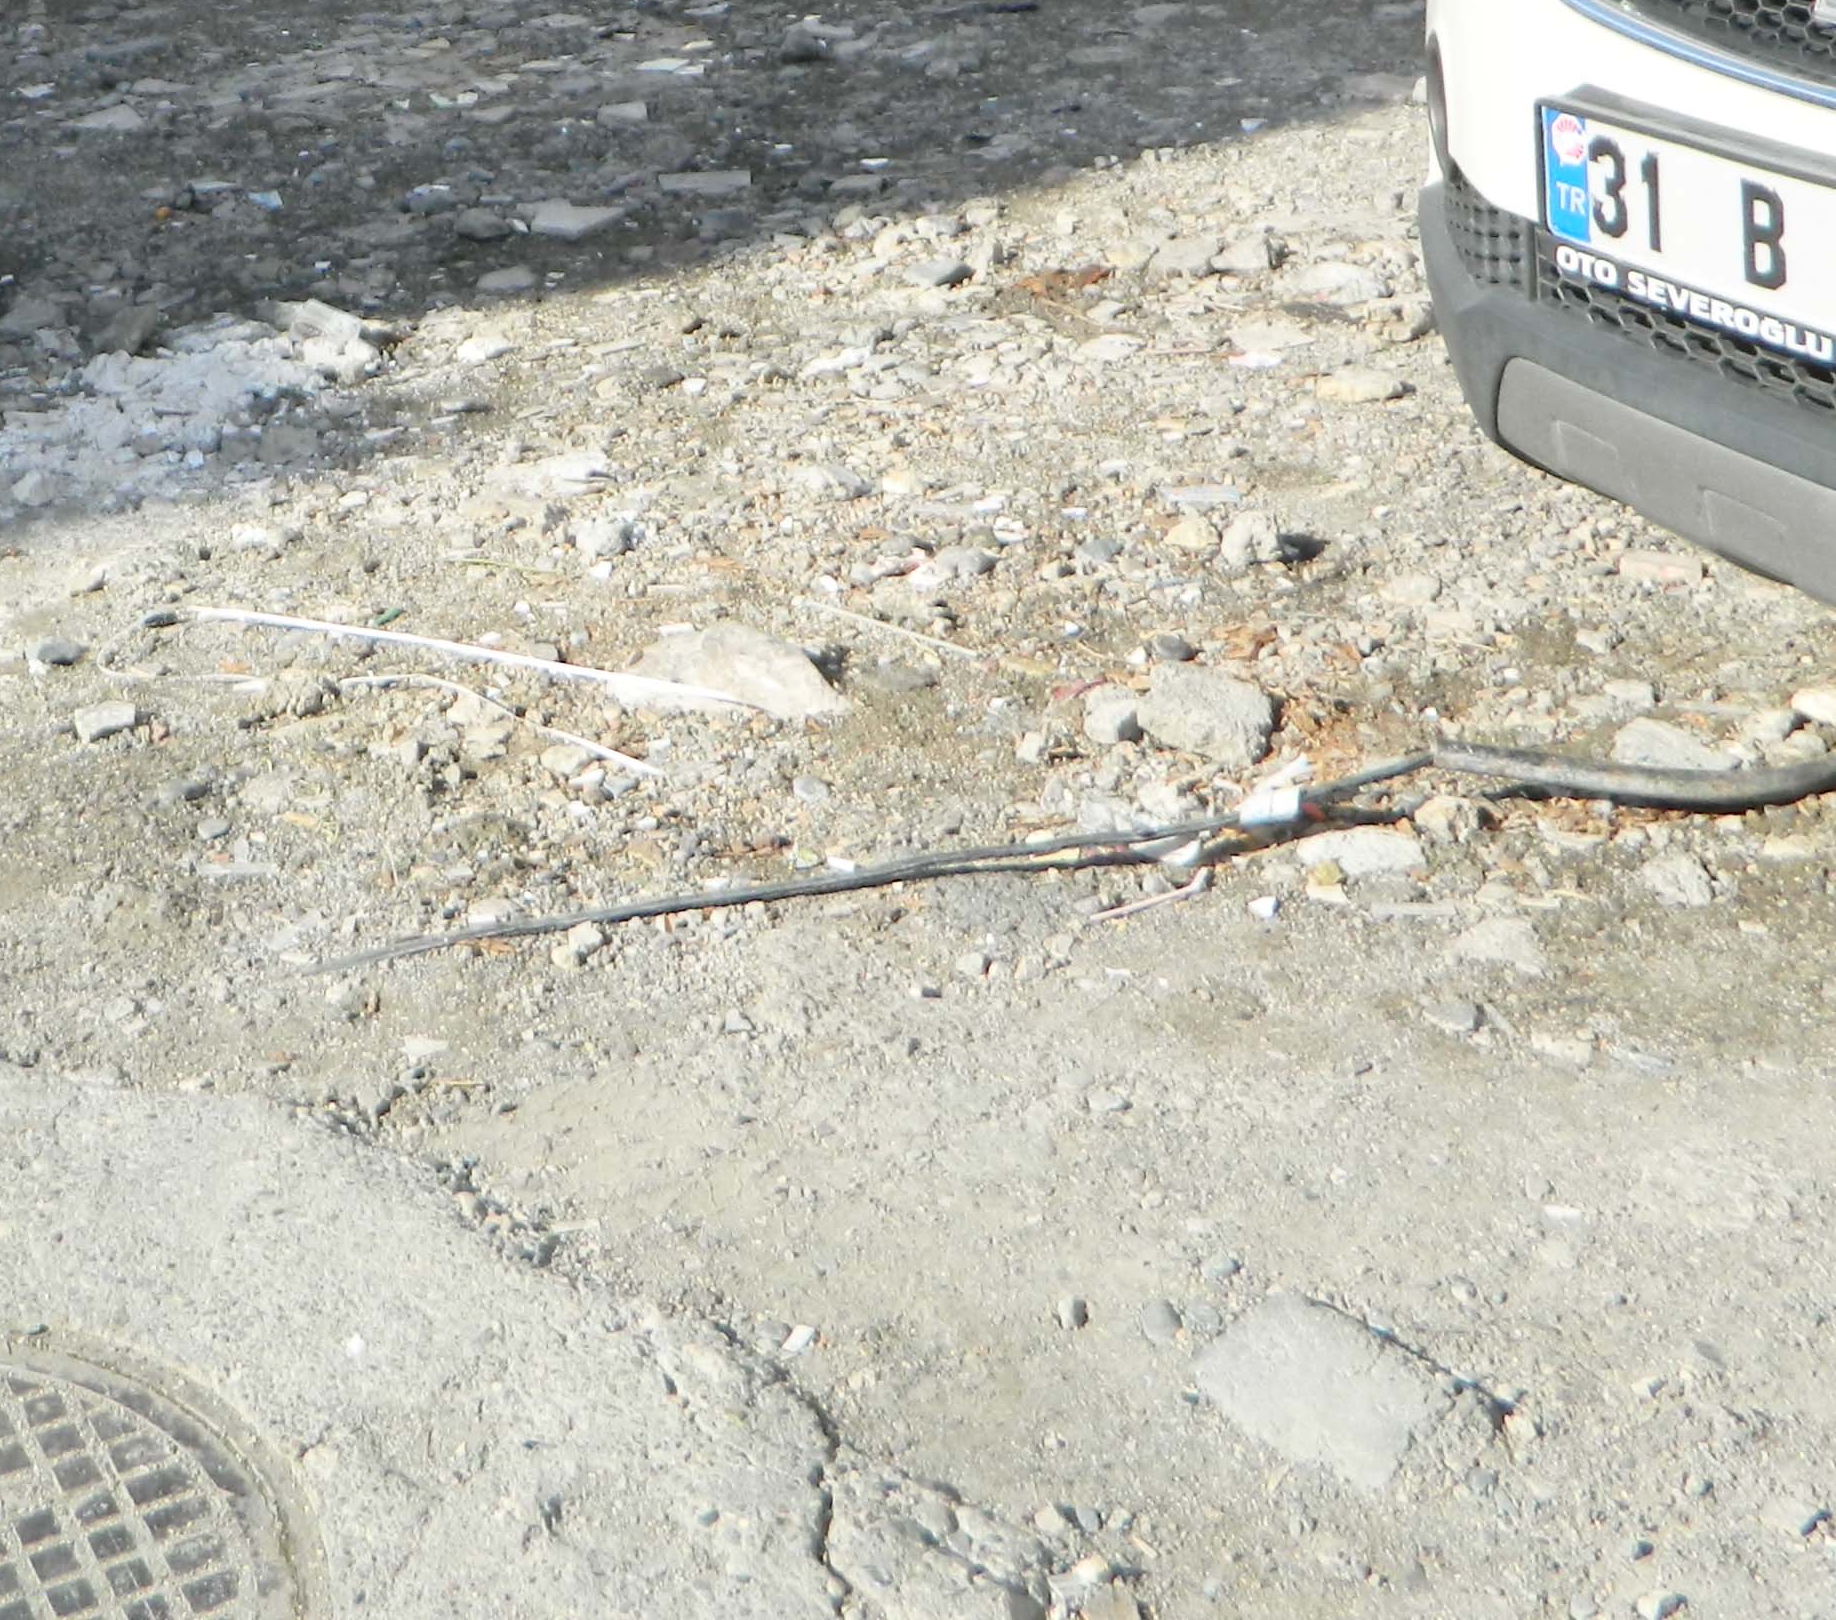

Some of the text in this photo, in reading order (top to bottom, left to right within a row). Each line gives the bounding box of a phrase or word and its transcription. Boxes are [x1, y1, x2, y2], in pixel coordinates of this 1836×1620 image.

[1555, 180, 1586, 216] TR
[1587, 134, 1787, 291] 31 B
[1555, 244, 1619, 286] OTO
